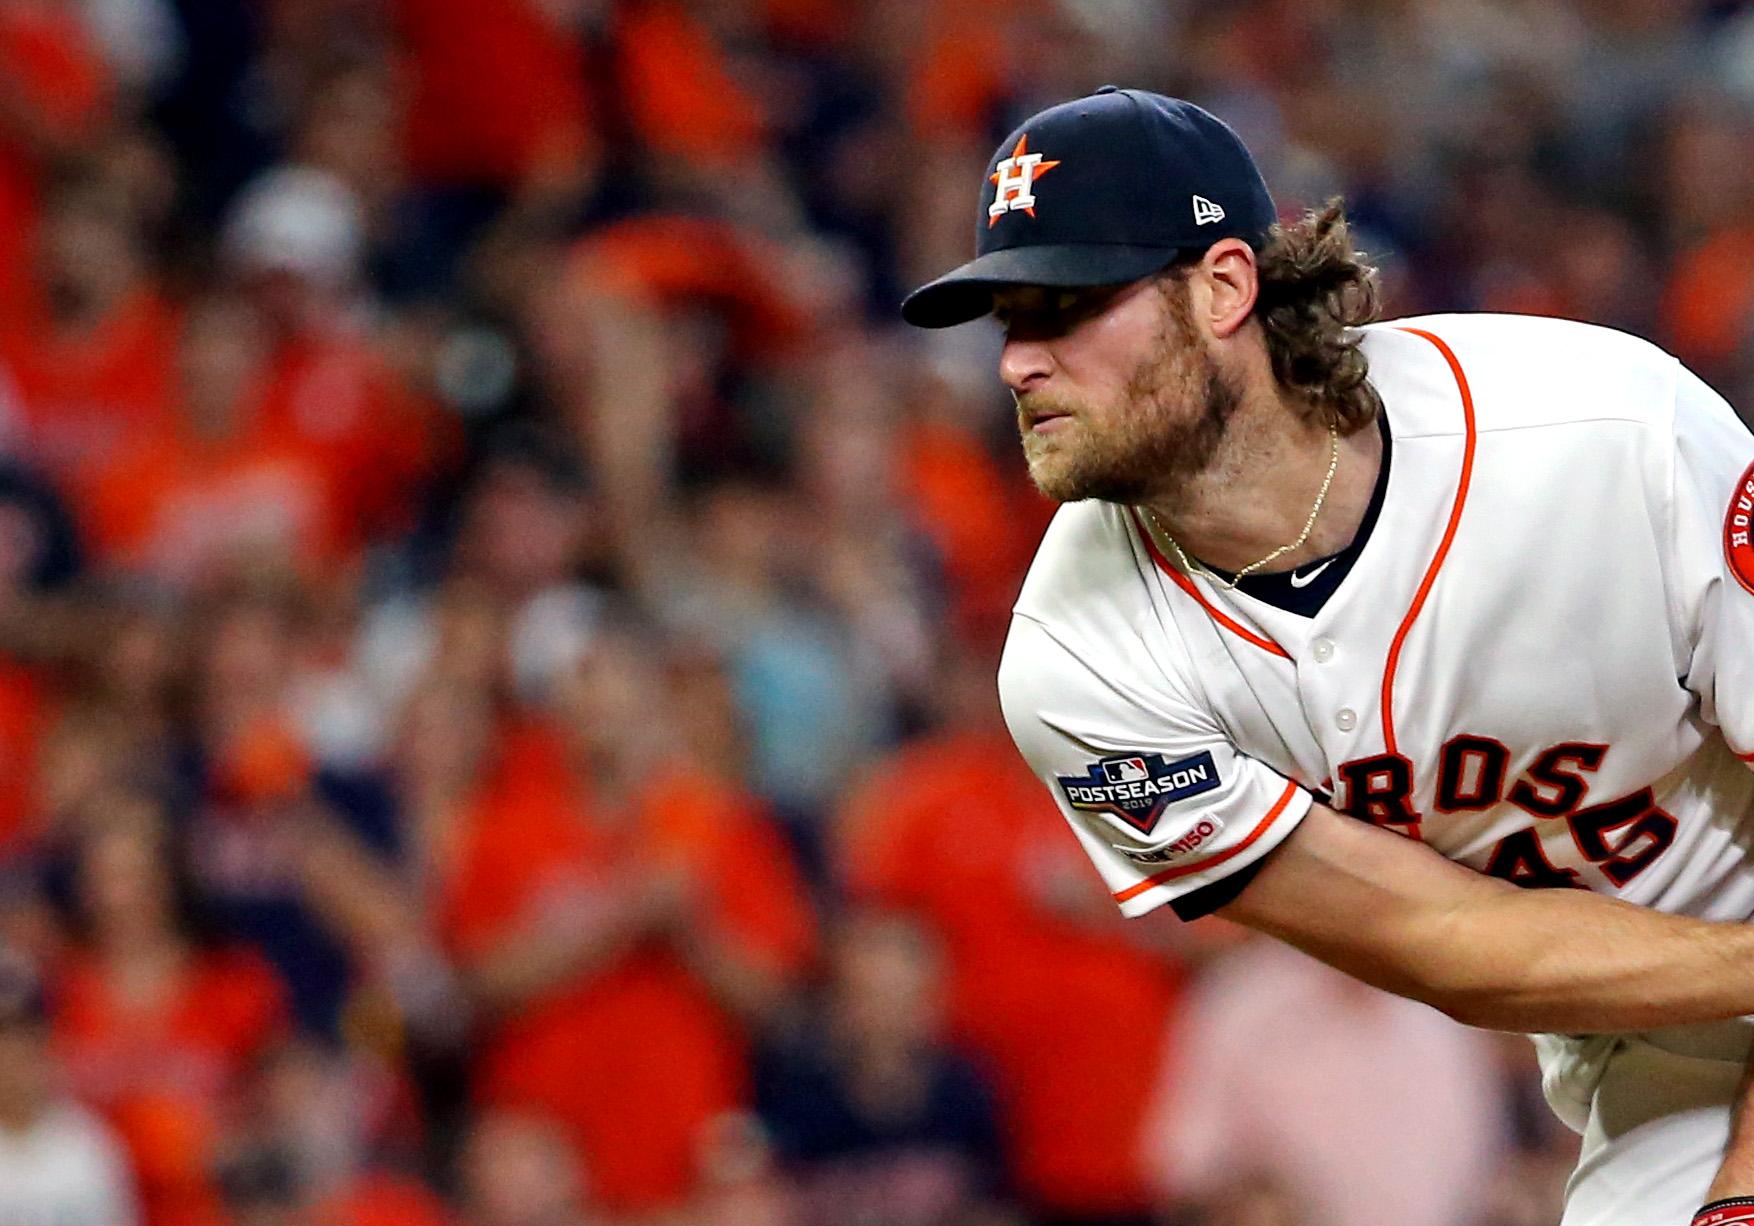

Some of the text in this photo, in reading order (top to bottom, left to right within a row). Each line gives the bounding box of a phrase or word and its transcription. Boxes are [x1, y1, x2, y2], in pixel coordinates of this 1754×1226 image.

[1067, 764, 1208, 802] POSTSEASON
[1122, 799, 1153, 810] 2019
[1312, 734, 1610, 824] ROS
[1482, 786, 1679, 890] 45
